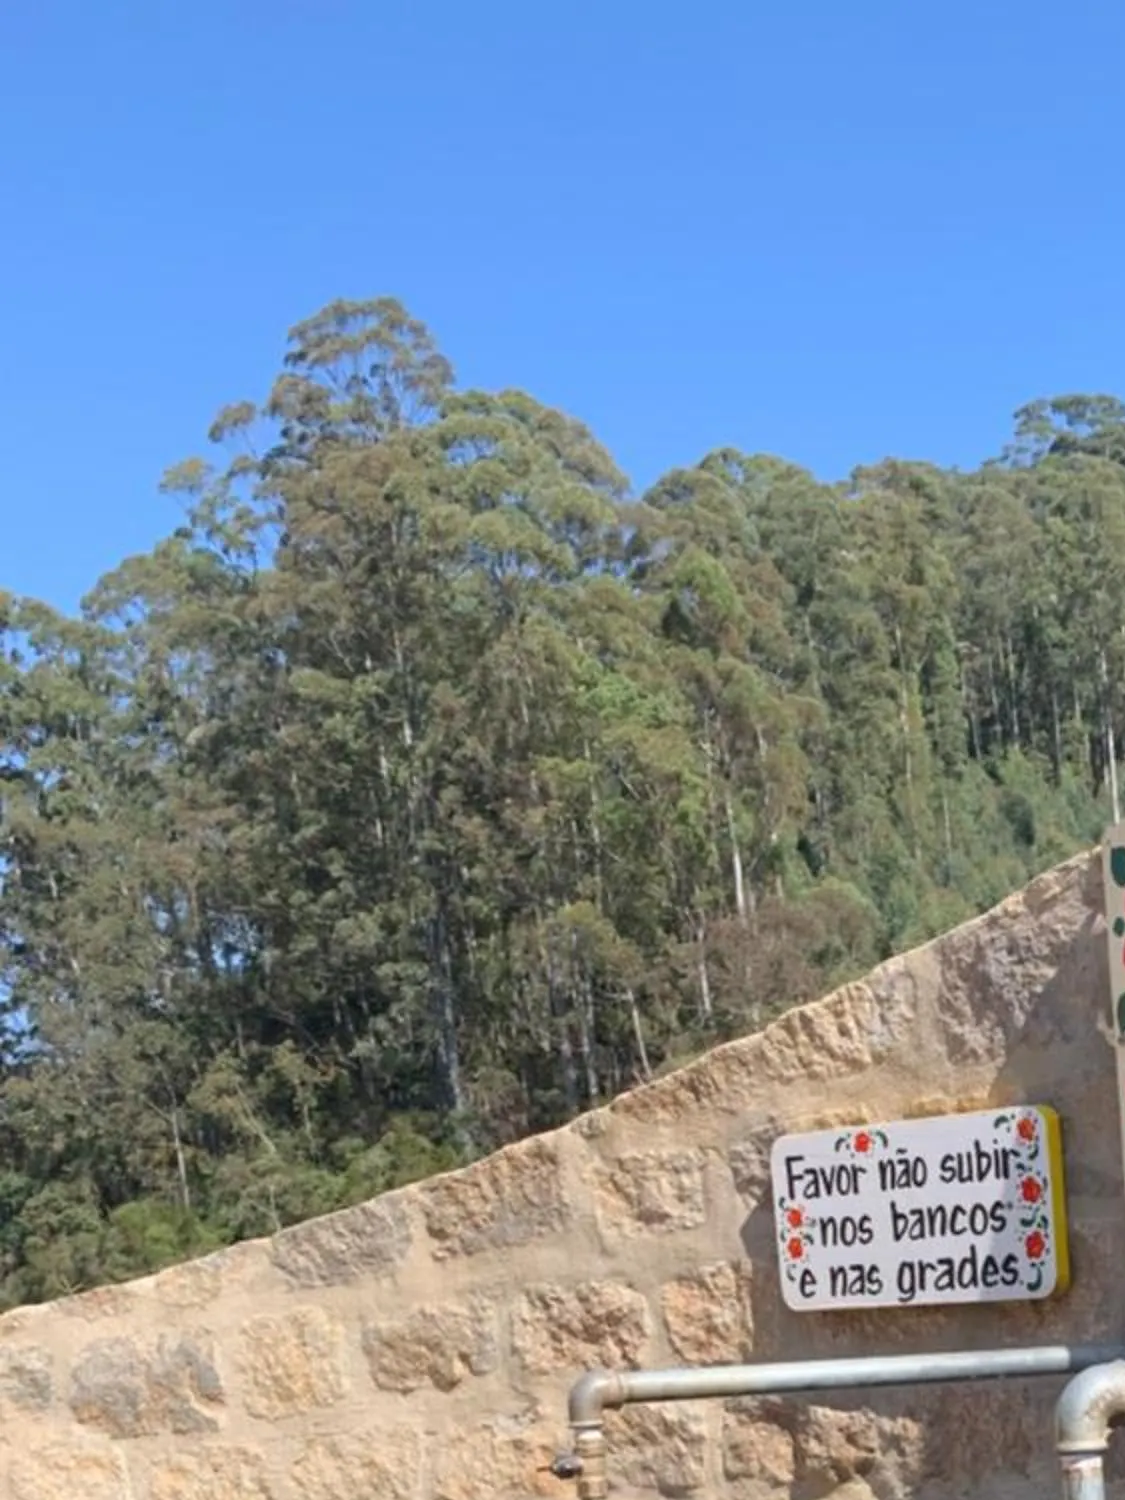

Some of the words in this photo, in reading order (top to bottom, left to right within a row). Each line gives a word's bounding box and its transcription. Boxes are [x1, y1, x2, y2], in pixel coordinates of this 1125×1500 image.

[785, 1155, 867, 1200] Favor
[878, 1148, 927, 1191] não
[939, 1139, 1017, 1184] subir
[820, 1213, 874, 1247] nos
[890, 1200, 1008, 1242] bancos
[800, 1267, 817, 1298] e
[829, 1262, 883, 1296] nas
